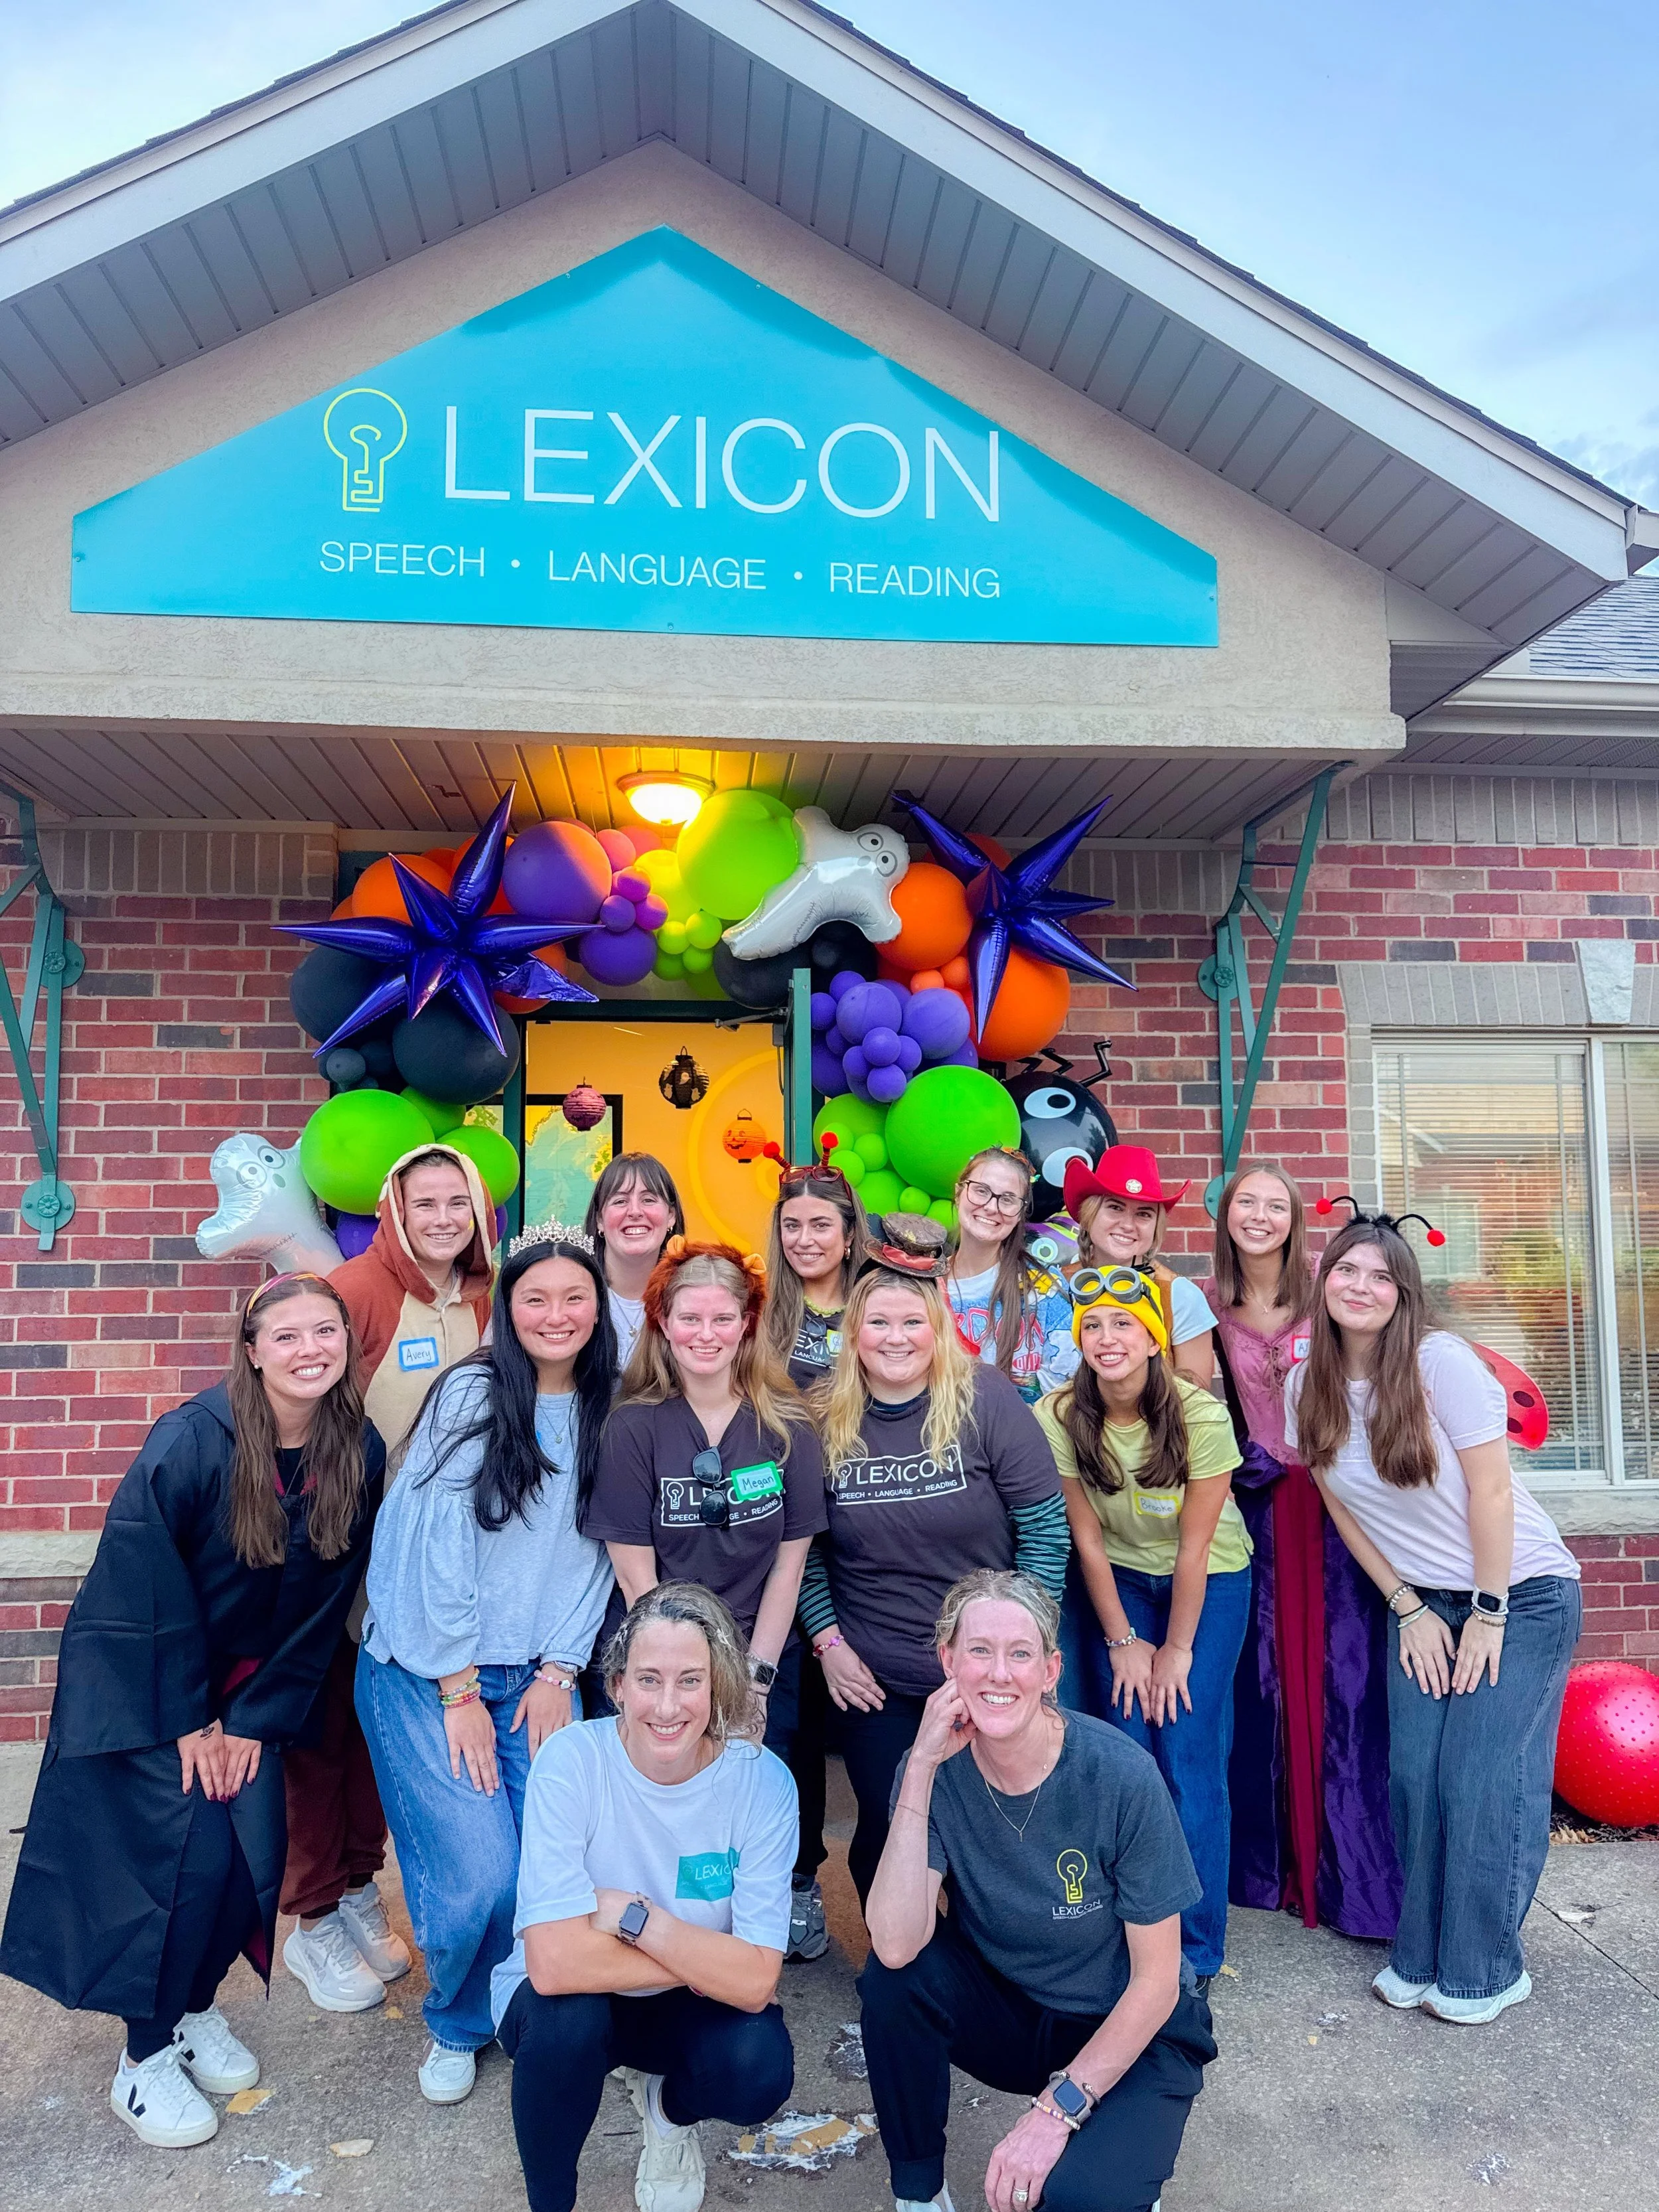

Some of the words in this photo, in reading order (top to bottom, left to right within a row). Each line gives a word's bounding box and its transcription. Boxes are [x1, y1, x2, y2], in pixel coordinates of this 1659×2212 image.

[445, 406, 999, 522] LEXICON
[320, 541, 484, 577] SPEECH
[549, 550, 766, 589] LANGUAGE
[830, 562, 1000, 599] READING
[406, 1348, 431, 1361] Avery
[741, 1475, 774, 1491] Megan
[839, 1491, 865, 1500] SPEECH
[875, 1487, 914, 1498] LANGUAGE
[925, 1479, 958, 1492] READING
[751, 1498, 778, 1516] READING
[1140, 1497, 1173, 1512] Brooke
[1052, 1899, 1101, 1916] LEXICON
